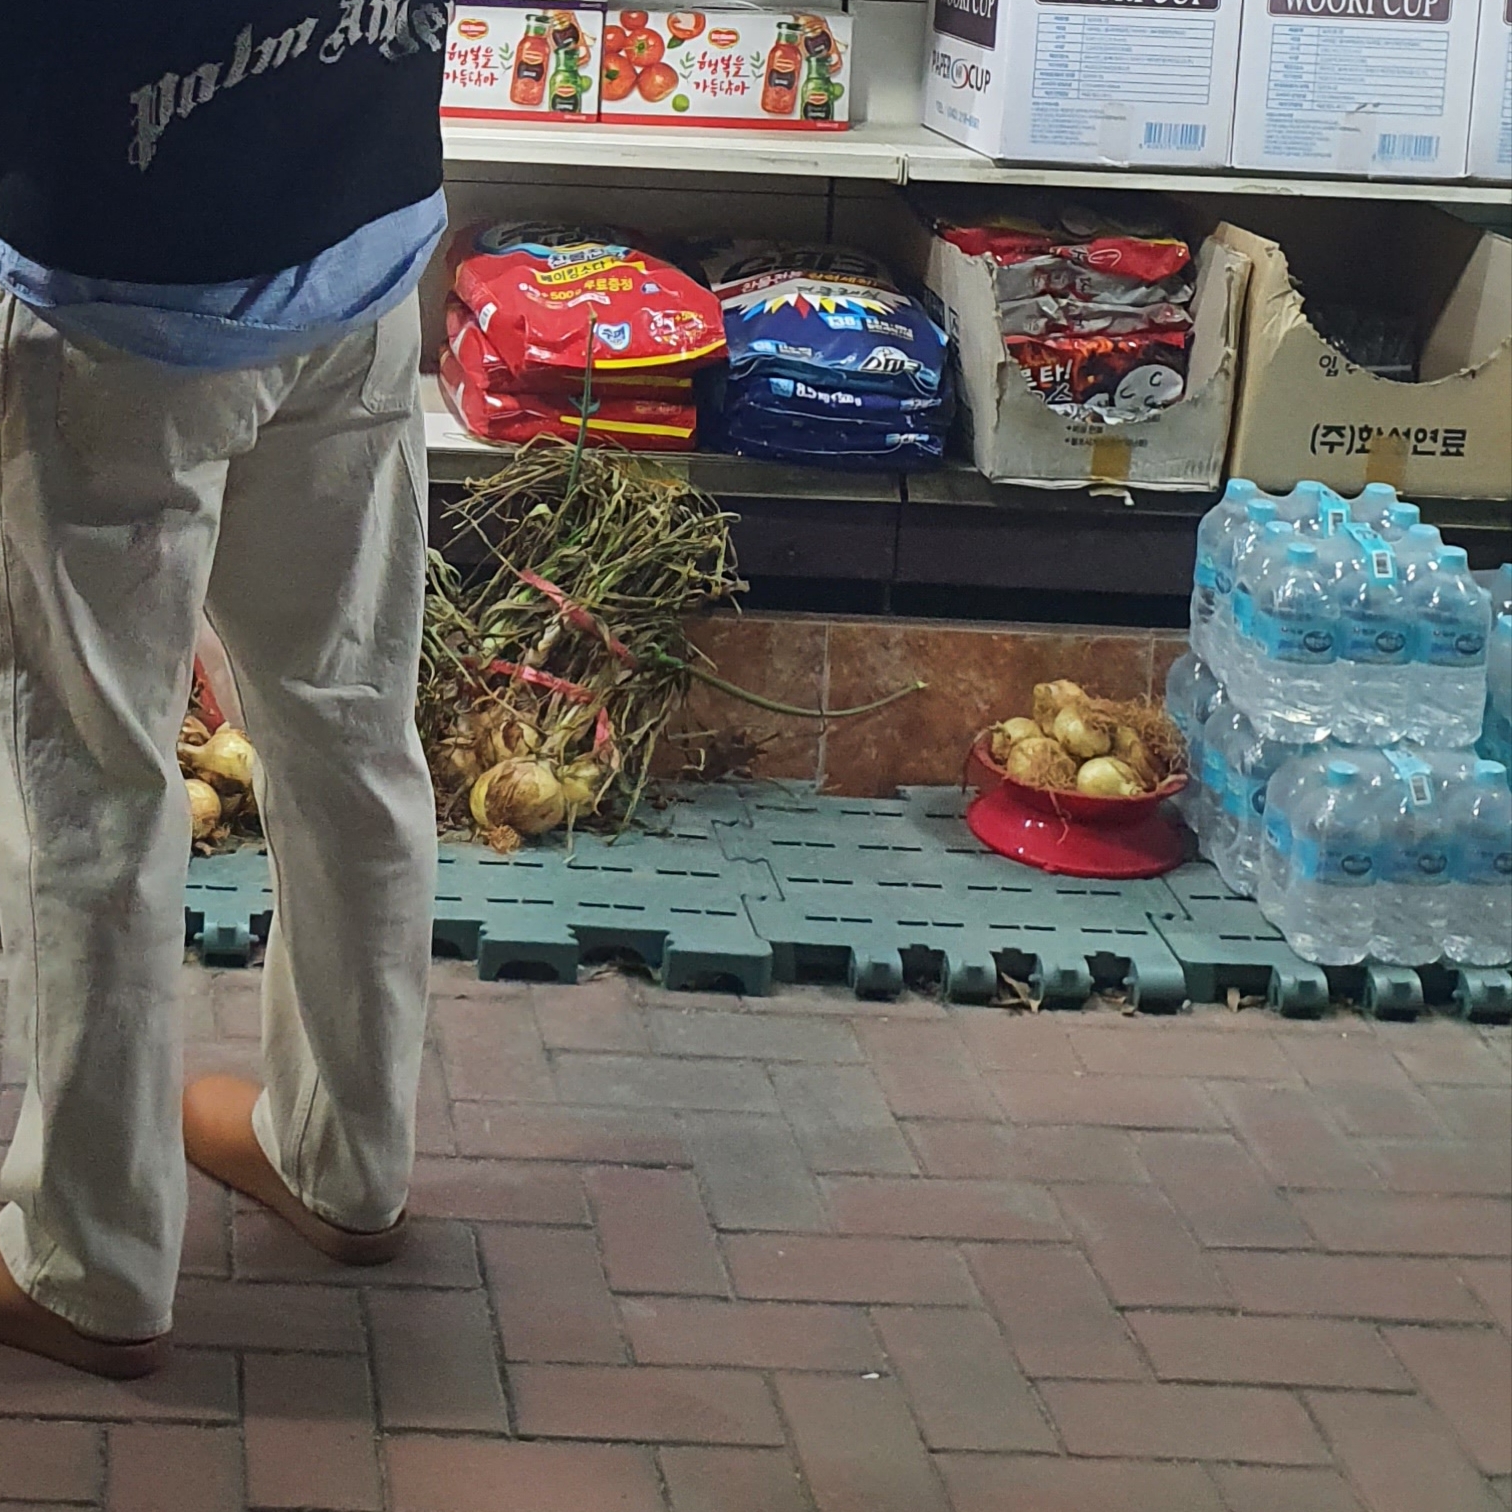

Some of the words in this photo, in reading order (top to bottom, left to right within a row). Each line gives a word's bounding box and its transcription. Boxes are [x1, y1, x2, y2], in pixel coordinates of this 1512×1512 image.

[446, 42, 499, 70] 행복을
[696, 50, 751, 79] 행복을
[443, 69, 499, 88] 가득담아
[932, 50, 952, 80] PAPER
[968, 64, 992, 94] CUP
[693, 78, 751, 98] 가득담아
